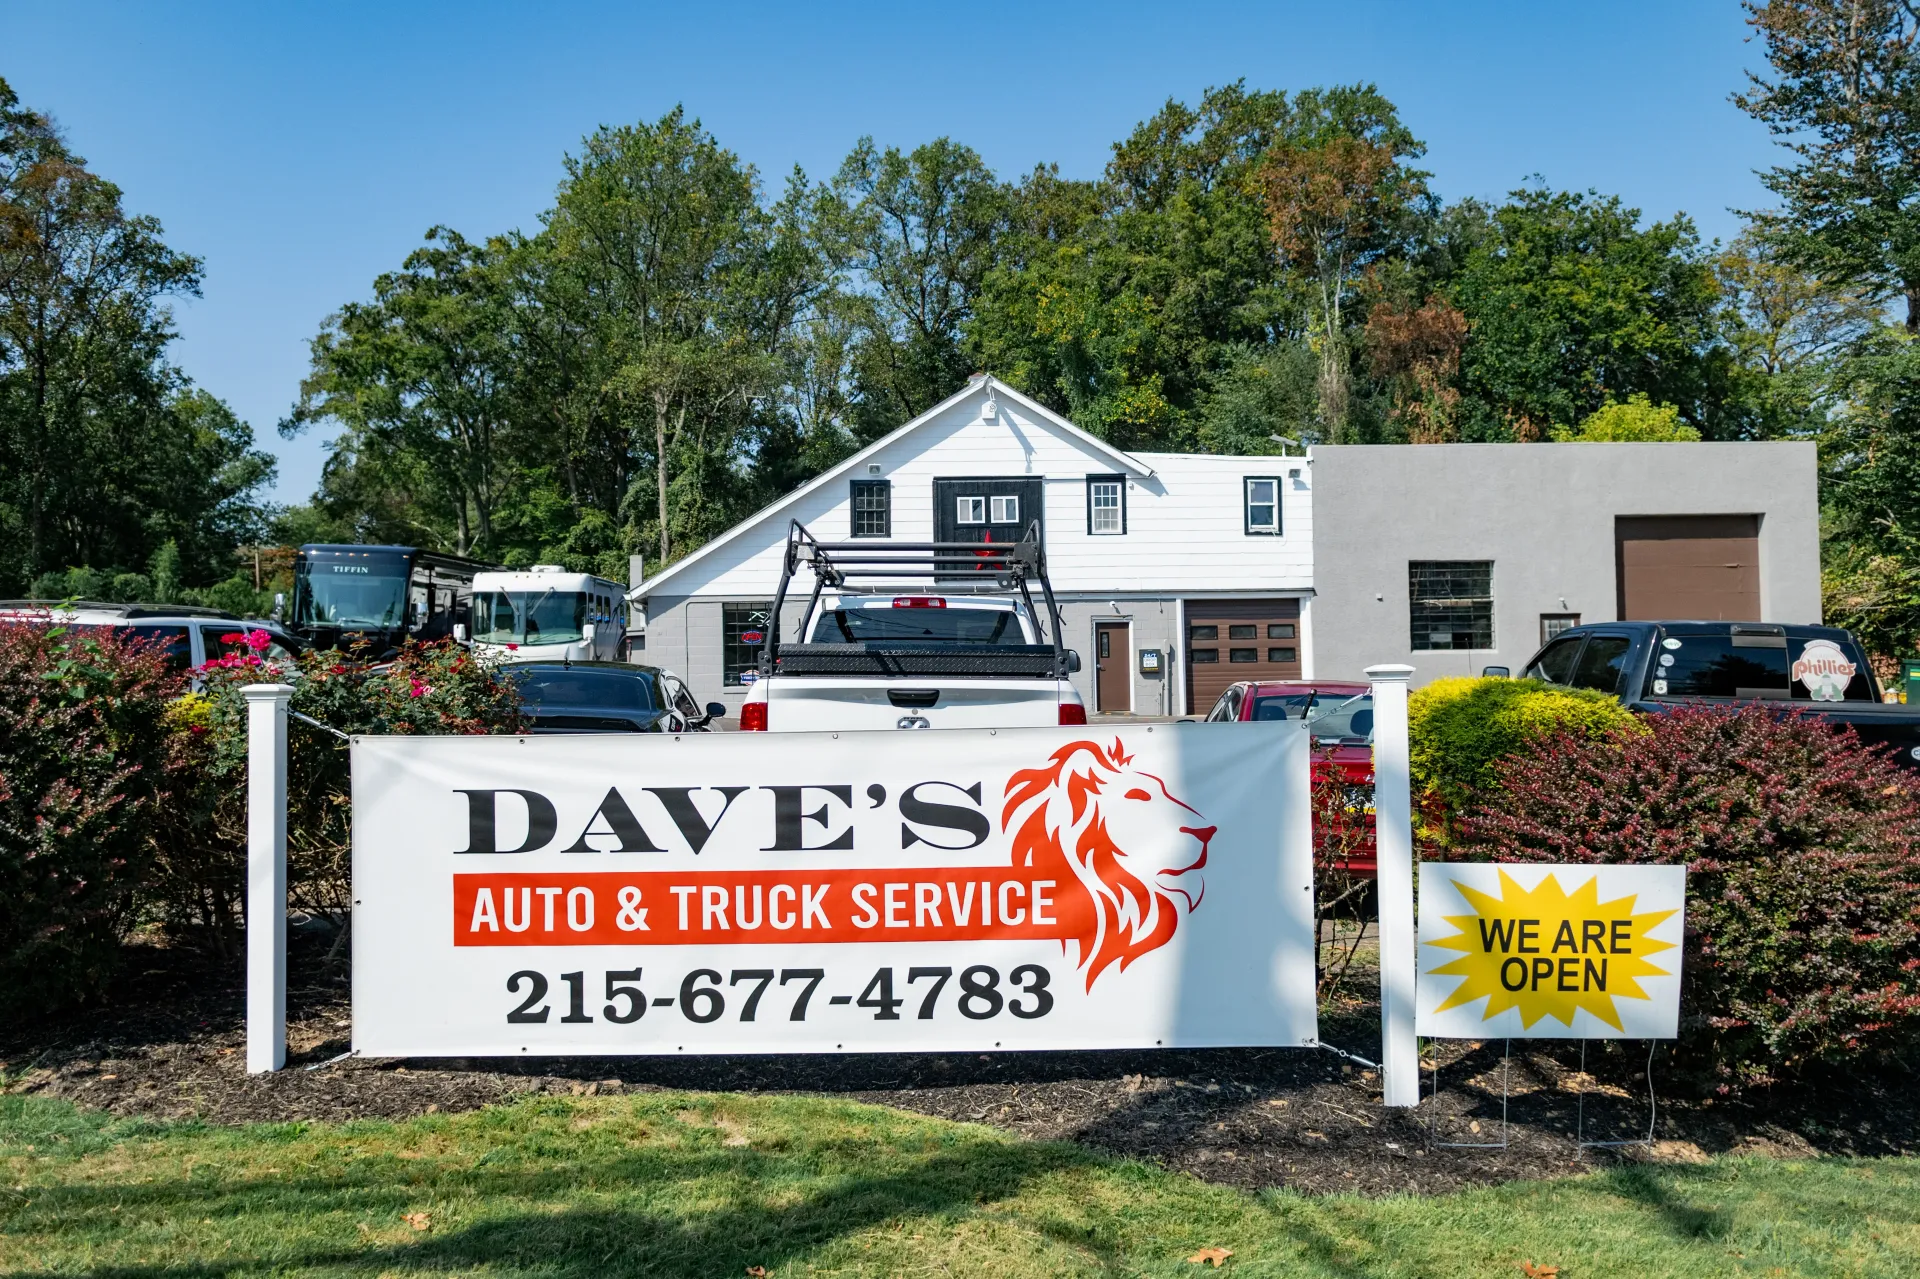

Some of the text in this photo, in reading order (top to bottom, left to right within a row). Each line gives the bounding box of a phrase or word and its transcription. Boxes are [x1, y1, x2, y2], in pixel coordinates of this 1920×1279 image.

[453, 782, 989, 854] DAVE'S
[470, 880, 1057, 932] AUTO & TRUCK SERVICE
[1479, 919, 1632, 954] WE ARE
[507, 965, 1053, 1024] 215-677-4783
[1500, 957, 1608, 992] OPEN
